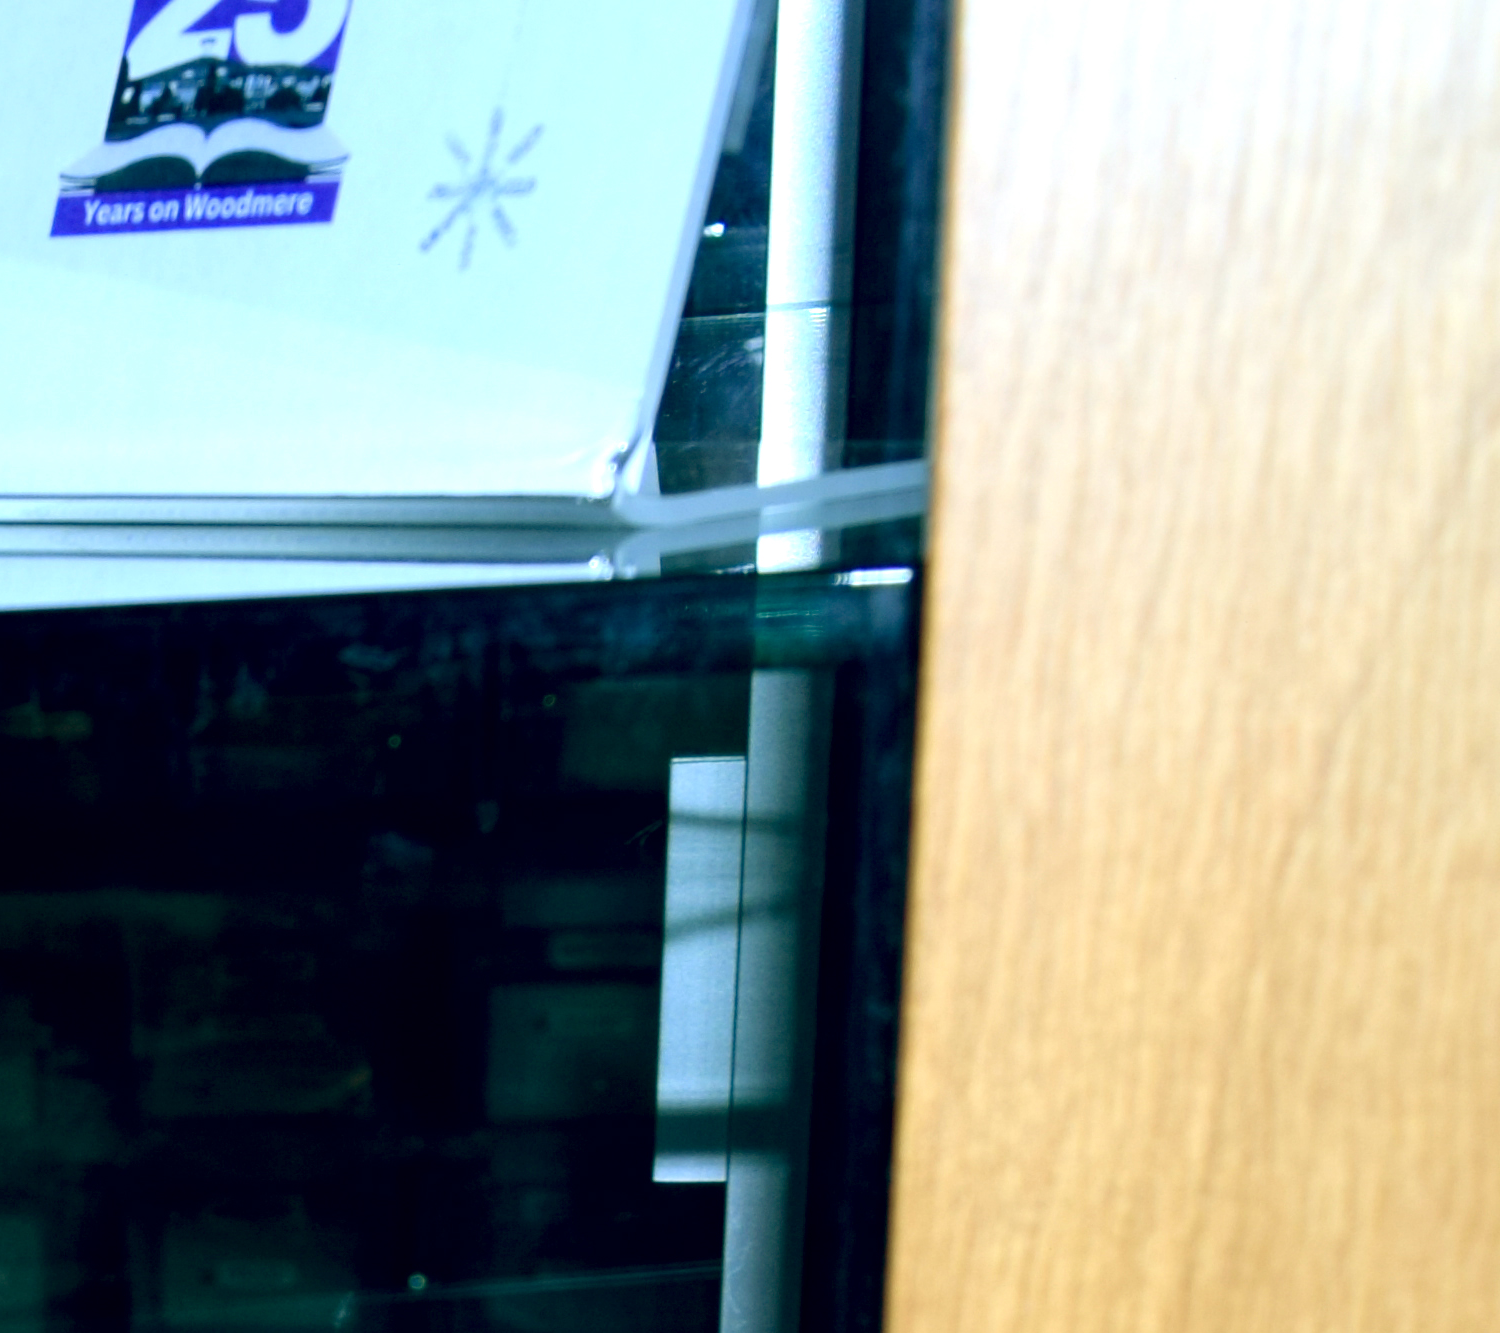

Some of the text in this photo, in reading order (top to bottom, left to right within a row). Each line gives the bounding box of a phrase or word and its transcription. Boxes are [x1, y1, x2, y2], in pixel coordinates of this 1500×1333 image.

[83, 188, 315, 226] Years on Woodmere
